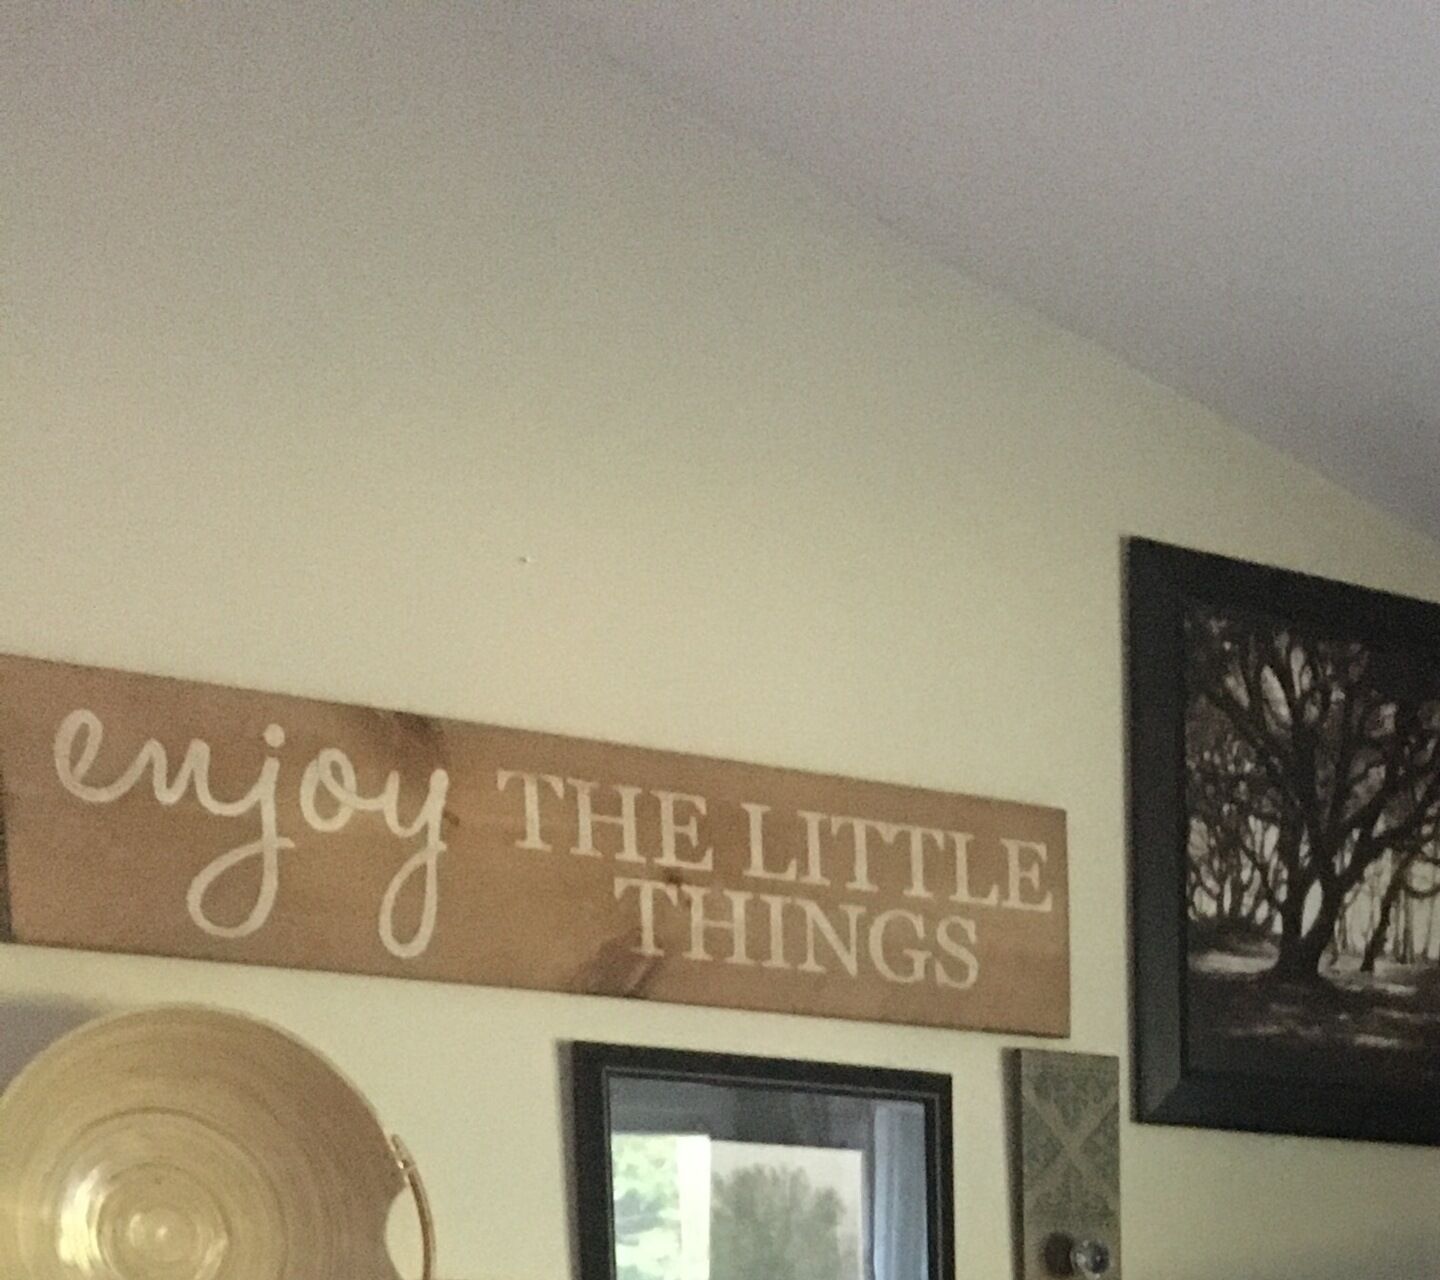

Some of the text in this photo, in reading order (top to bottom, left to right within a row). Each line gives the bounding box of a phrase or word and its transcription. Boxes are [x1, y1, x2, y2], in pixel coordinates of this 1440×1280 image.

[54, 708, 450, 958] enjoy
[498, 769, 1054, 912] THE LITTLE
[614, 877, 980, 989] THINGS
